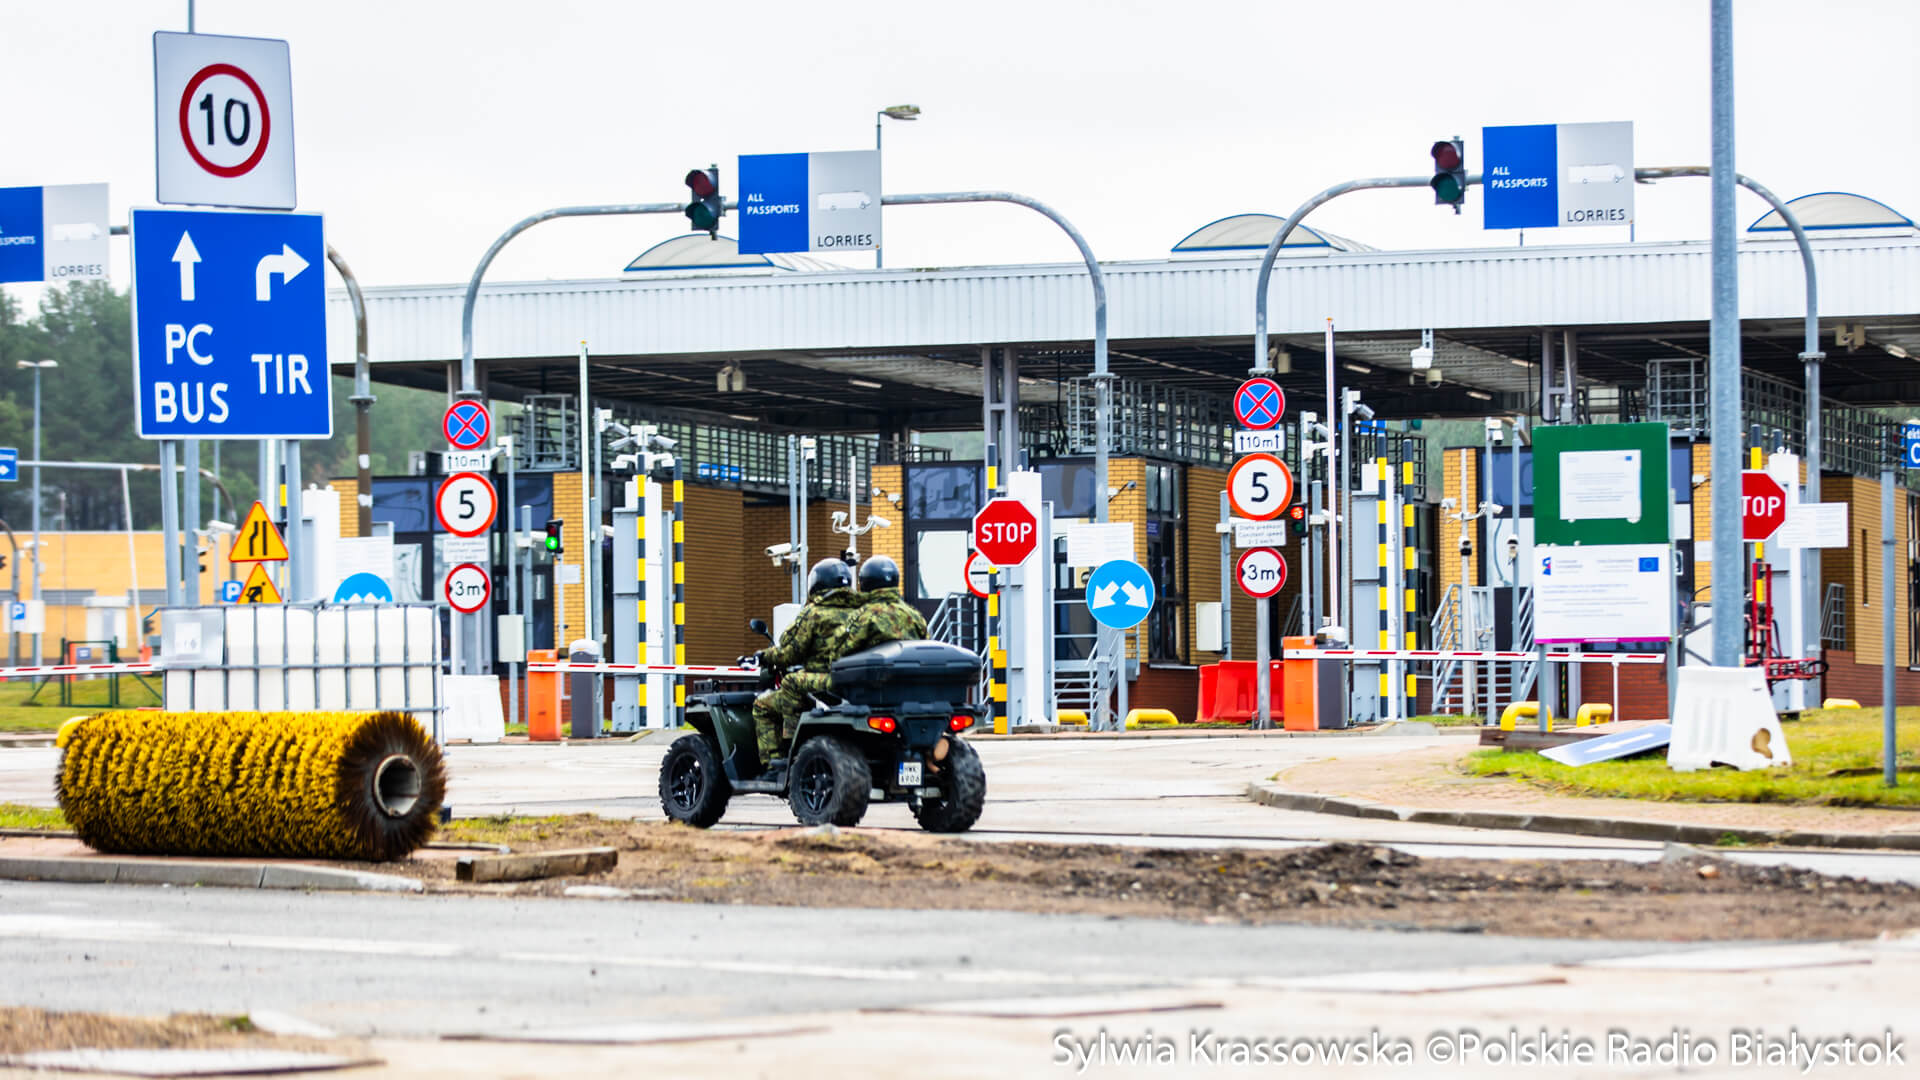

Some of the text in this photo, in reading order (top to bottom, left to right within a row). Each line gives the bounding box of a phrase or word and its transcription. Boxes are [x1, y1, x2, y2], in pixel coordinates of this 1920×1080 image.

[199, 93, 251, 146] 10
[1491, 166, 1510, 176] ALL
[1491, 178, 1548, 189] PASSPORTS
[747, 193, 764, 202] ALL
[746, 204, 800, 215] PASSPORTS
[1567, 209, 1625, 222] LORRIES
[817, 234, 872, 247] LORRIES
[52, 264, 103, 277] LORRIES
[165, 323, 214, 365] PC
[251, 353, 312, 395] TIR
[154, 381, 230, 423] BUS
[1251, 471, 1269, 503] 5
[458, 489, 475, 519] 5
[1741, 496, 1781, 517] TOP
[980, 522, 1033, 543] STOP
[227, 583, 240, 601] P
